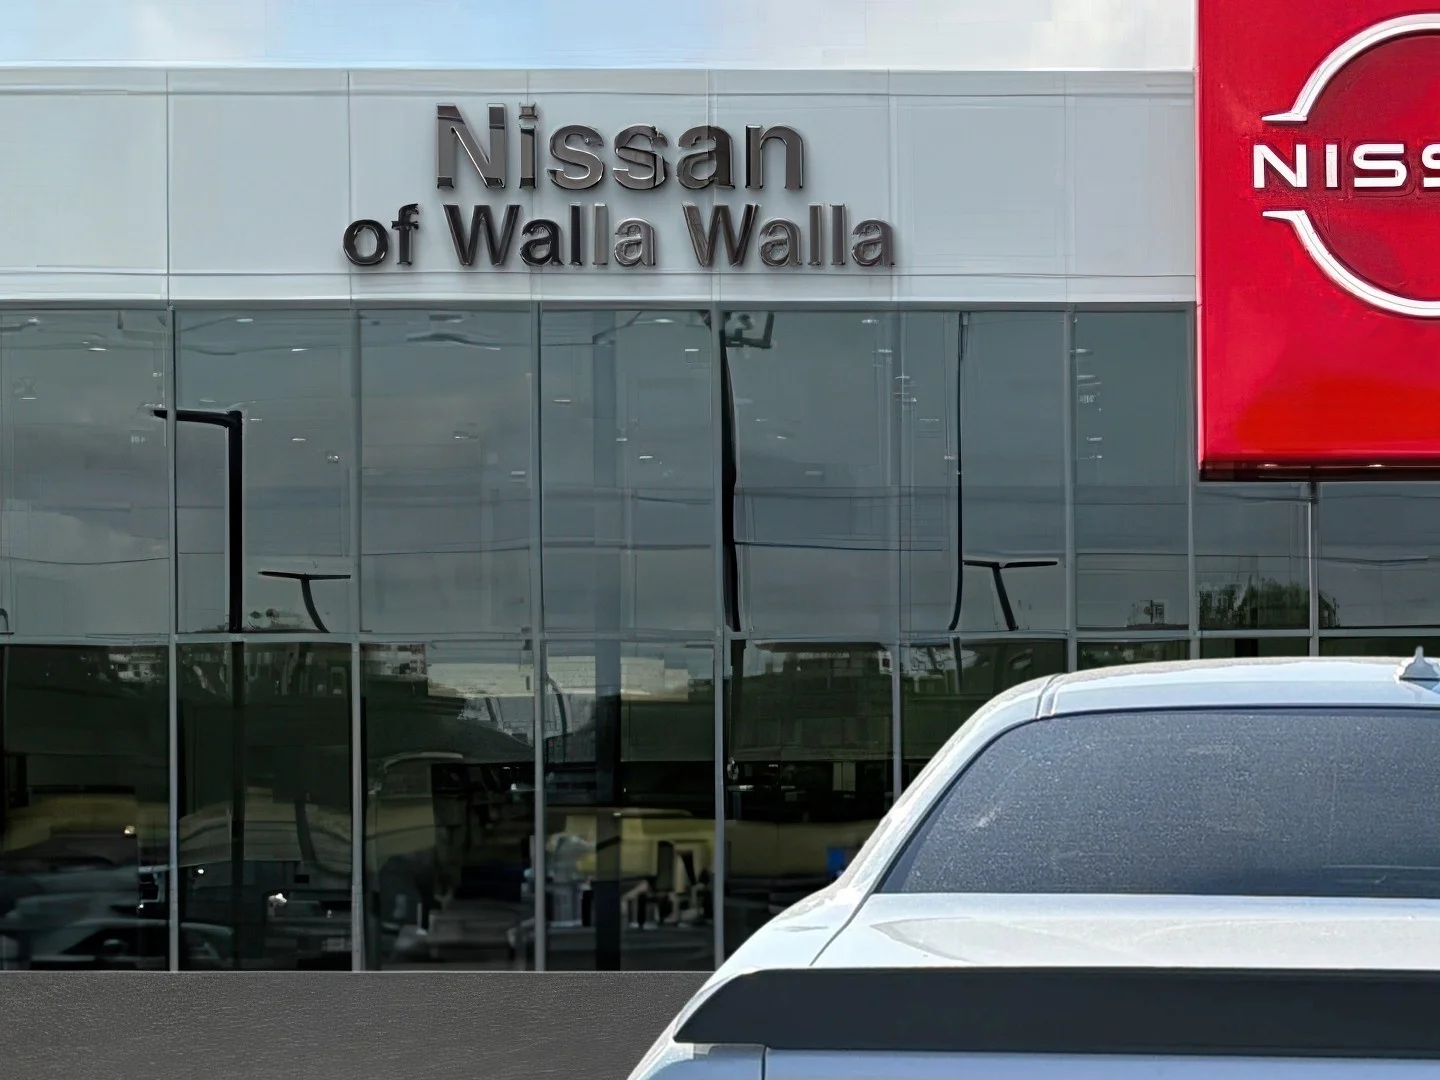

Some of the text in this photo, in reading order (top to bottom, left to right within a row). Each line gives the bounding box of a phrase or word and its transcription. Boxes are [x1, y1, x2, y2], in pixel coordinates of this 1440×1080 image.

[436, 102, 804, 191] Nissan
[343, 203, 897, 267] of Walla Walla
